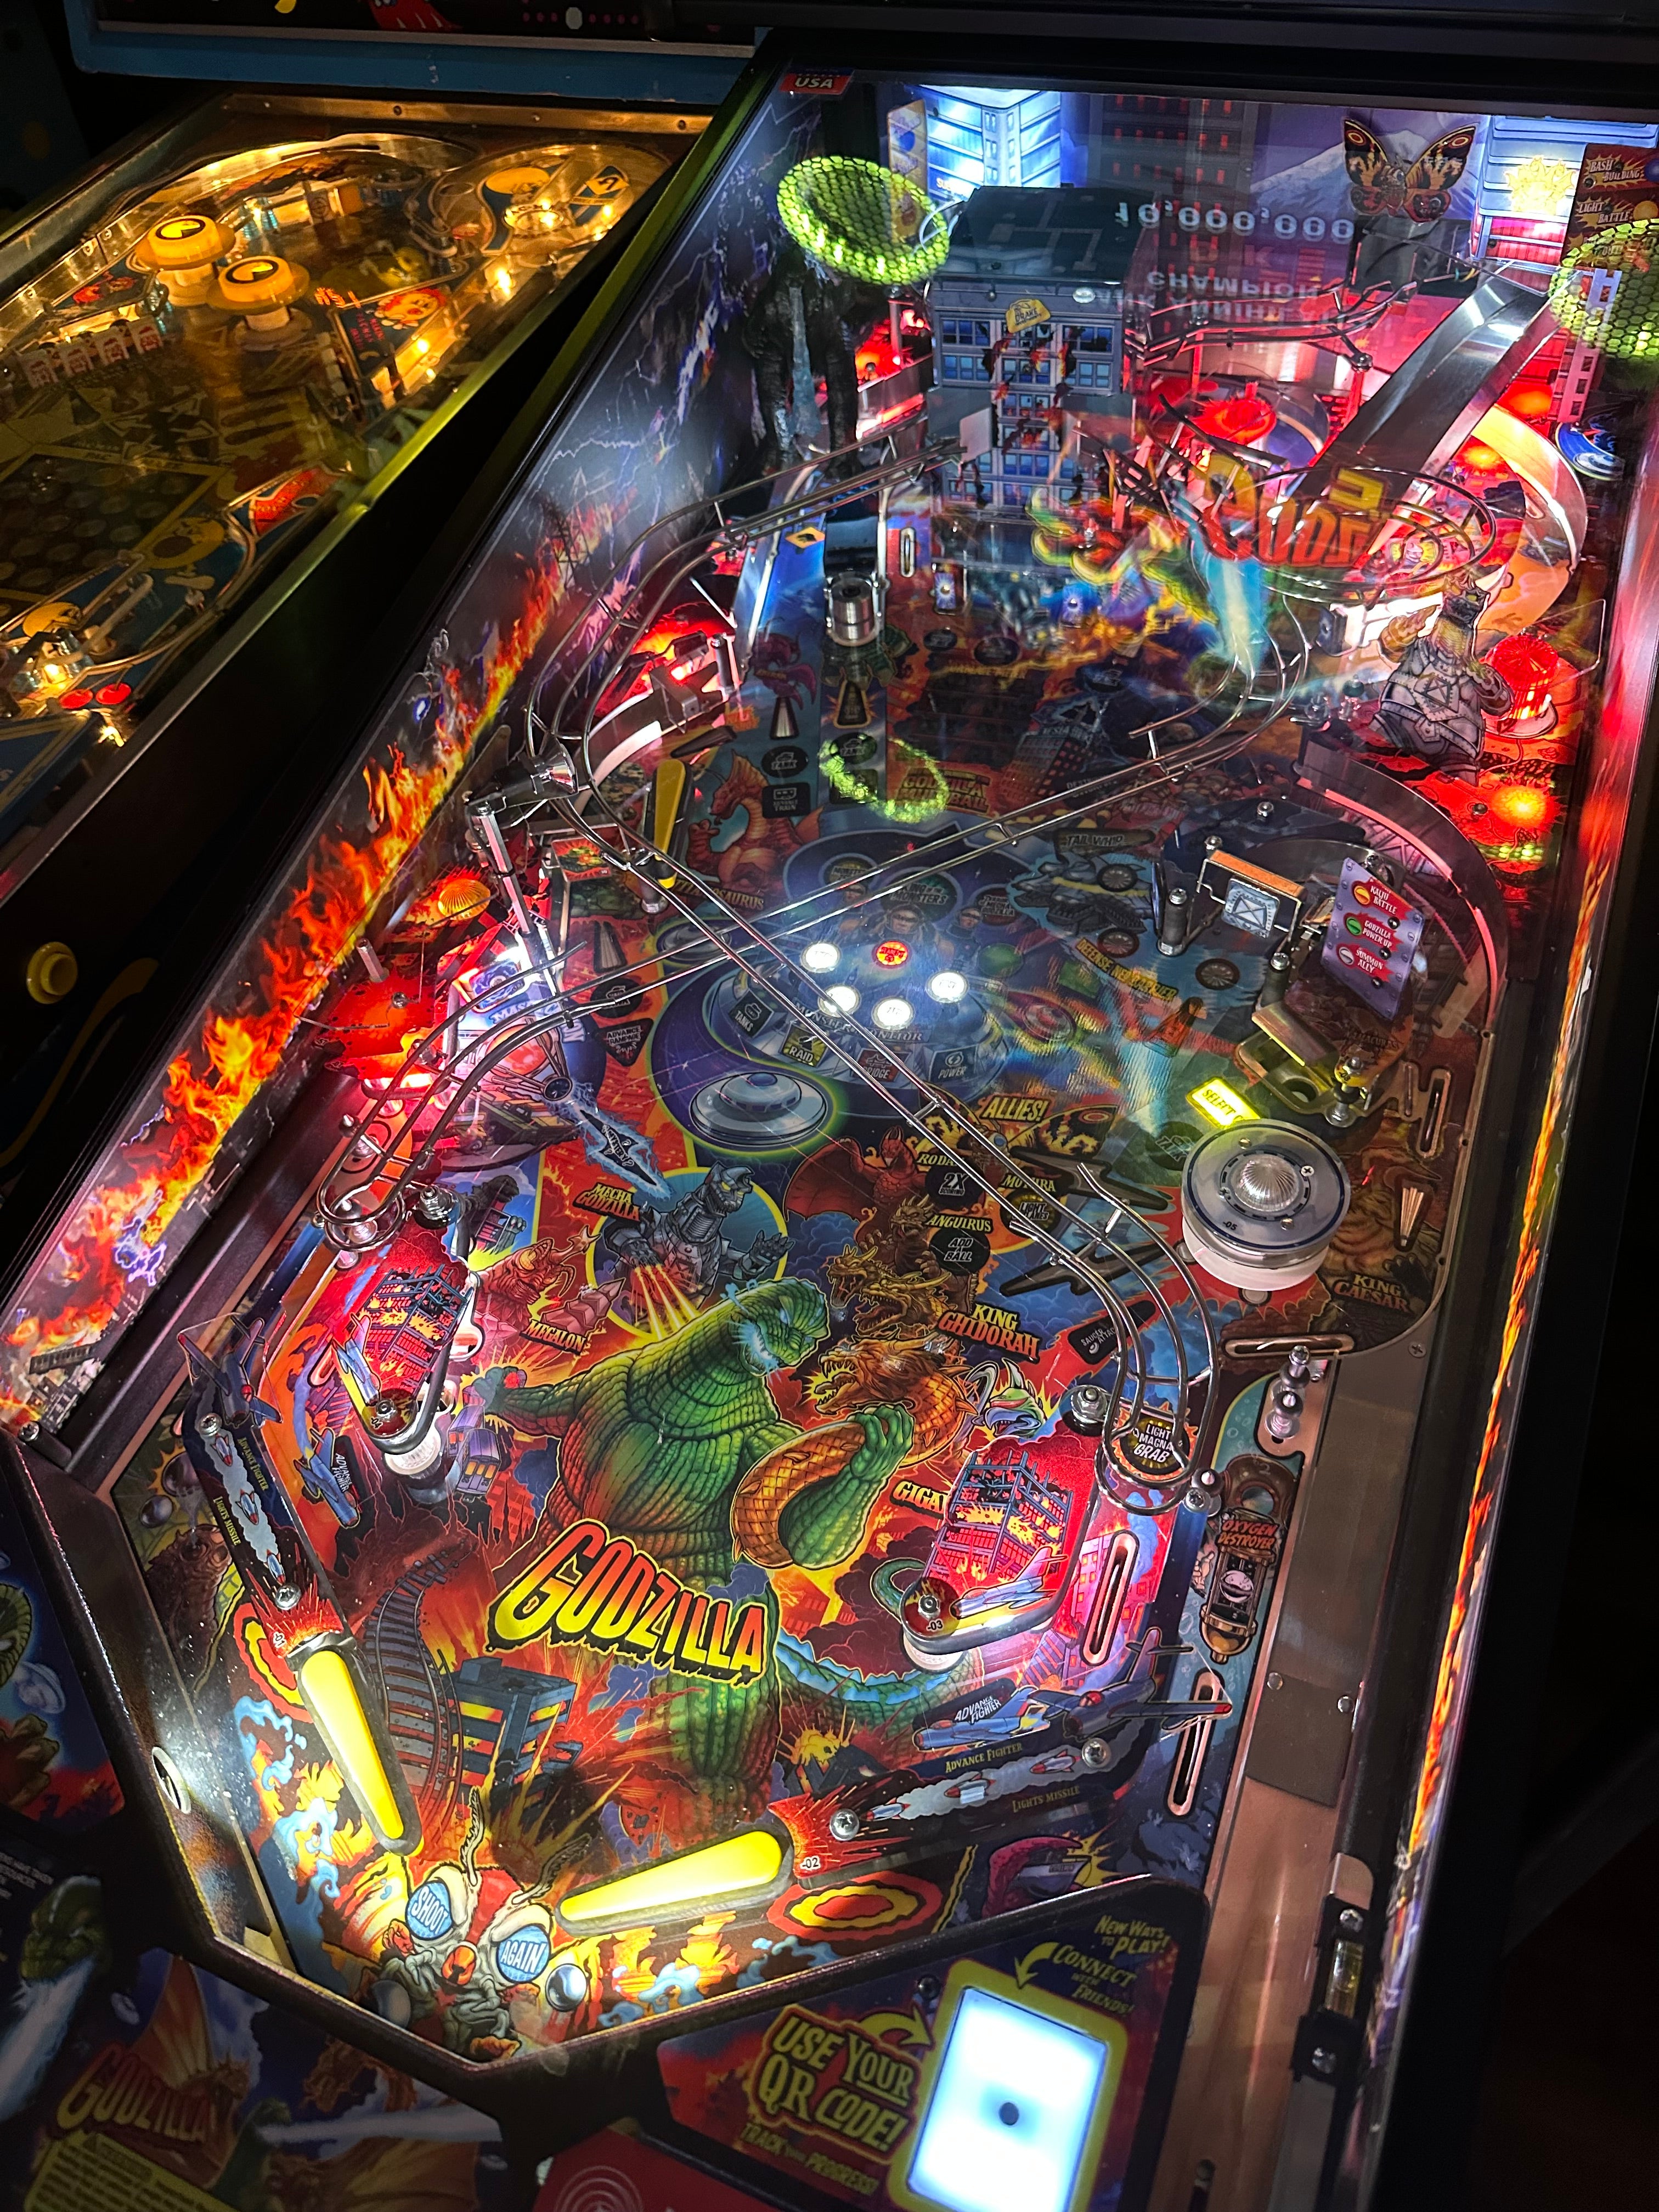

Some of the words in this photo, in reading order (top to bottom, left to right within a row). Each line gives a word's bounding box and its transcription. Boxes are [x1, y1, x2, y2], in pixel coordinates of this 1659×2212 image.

[795, 77, 833, 89] USA
[1590, 160, 1613, 172] BASH
[1603, 169, 1640, 182] BUILDING
[1579, 201, 1604, 213] LIGHT
[1597, 210, 1630, 224] BATTLE
[1066, 833, 1091, 846] TAIL
[1091, 833, 1125, 845] WHIP
[1369, 885, 1390, 901] KAIJU
[1373, 896, 1397, 915] BATTLE
[1362, 928, 1383, 944] POWER
[1382, 936, 1392, 948] UP
[1364, 920, 1391, 939] GODZILLA
[1356, 949, 1384, 970] SUMMON
[1358, 960, 1375, 974] ALLY
[734, 1010, 754, 1033] TANKS
[788, 1045, 814, 1063] RAID
[938, 1066, 967, 1080] POWER
[983, 1097, 1048, 1121] ALLIES!
[1202, 1089, 1237, 1115] SELECT
[917, 1153, 964, 1166] RODA
[944, 1172, 970, 1191] 2X
[591, 1183, 633, 1204] MECHA
[938, 1187, 966, 1197] SCORING
[575, 1191, 640, 1222] GODZILLA
[924, 1214, 992, 1232] ANGUIRUS
[1222, 1221, 1238, 1231] -05
[947, 1237, 974, 1249] ADD
[943, 1250, 973, 1262] BALL
[1352, 1274, 1402, 1297] KING
[1334, 1281, 1410, 1312] CAESAR
[971, 1304, 1018, 1330] KING
[524, 1320, 586, 1353] MEGALON
[938, 1312, 1041, 1362] GHIDORAH
[1080, 1328, 1103, 1346] SAUCER
[1097, 1327, 1117, 1345] ATTAC
[1146, 1424, 1172, 1440] LIGHT
[1138, 1433, 1174, 1451] MAGNA
[1133, 1443, 1170, 1463] GRAB
[238, 1437, 256, 1465] ADVANCE
[252, 1464, 269, 1491] FIGHTER
[331, 1467, 349, 1493] FIGHTER
[213, 1496, 230, 1520] LIGHTS
[224, 1520, 241, 1546] MISSILE
[1222, 1520, 1278, 1537] OXYGEN
[1217, 1532, 1276, 1549] DESTROYER
[494, 1522, 767, 1675] GODZILLA
[927, 1620, 944, 1631] -03
[274, 1633, 286, 1647] -01
[955, 1695, 994, 1723] ADVANCE
[970, 1699, 1002, 1725] FIGHTER
[945, 1752, 985, 1774] ADVANCE
[986, 1742, 1024, 1763] FIGHTER
[1012, 1793, 1045, 1814] LIGHTS
[1045, 1785, 1081, 1805] MISSILE
[801, 1857, 820, 1869] -02
[411, 1887, 449, 1935] SHOOT
[1094, 1915, 1128, 1934] NEW
[1128, 1920, 1165, 1937] WAYS
[500, 1940, 546, 1974] AGAIN
[1101, 1936, 1115, 1946] TO
[1109, 1935, 1171, 1960] PLAY!
[1052, 1944, 1138, 1987] CONNECT
[772, 2015, 845, 2070] USE
[842, 2032, 914, 2101] YOUR
[759, 2053, 816, 2123] QR
[815, 2088, 909, 2152] CODE!
